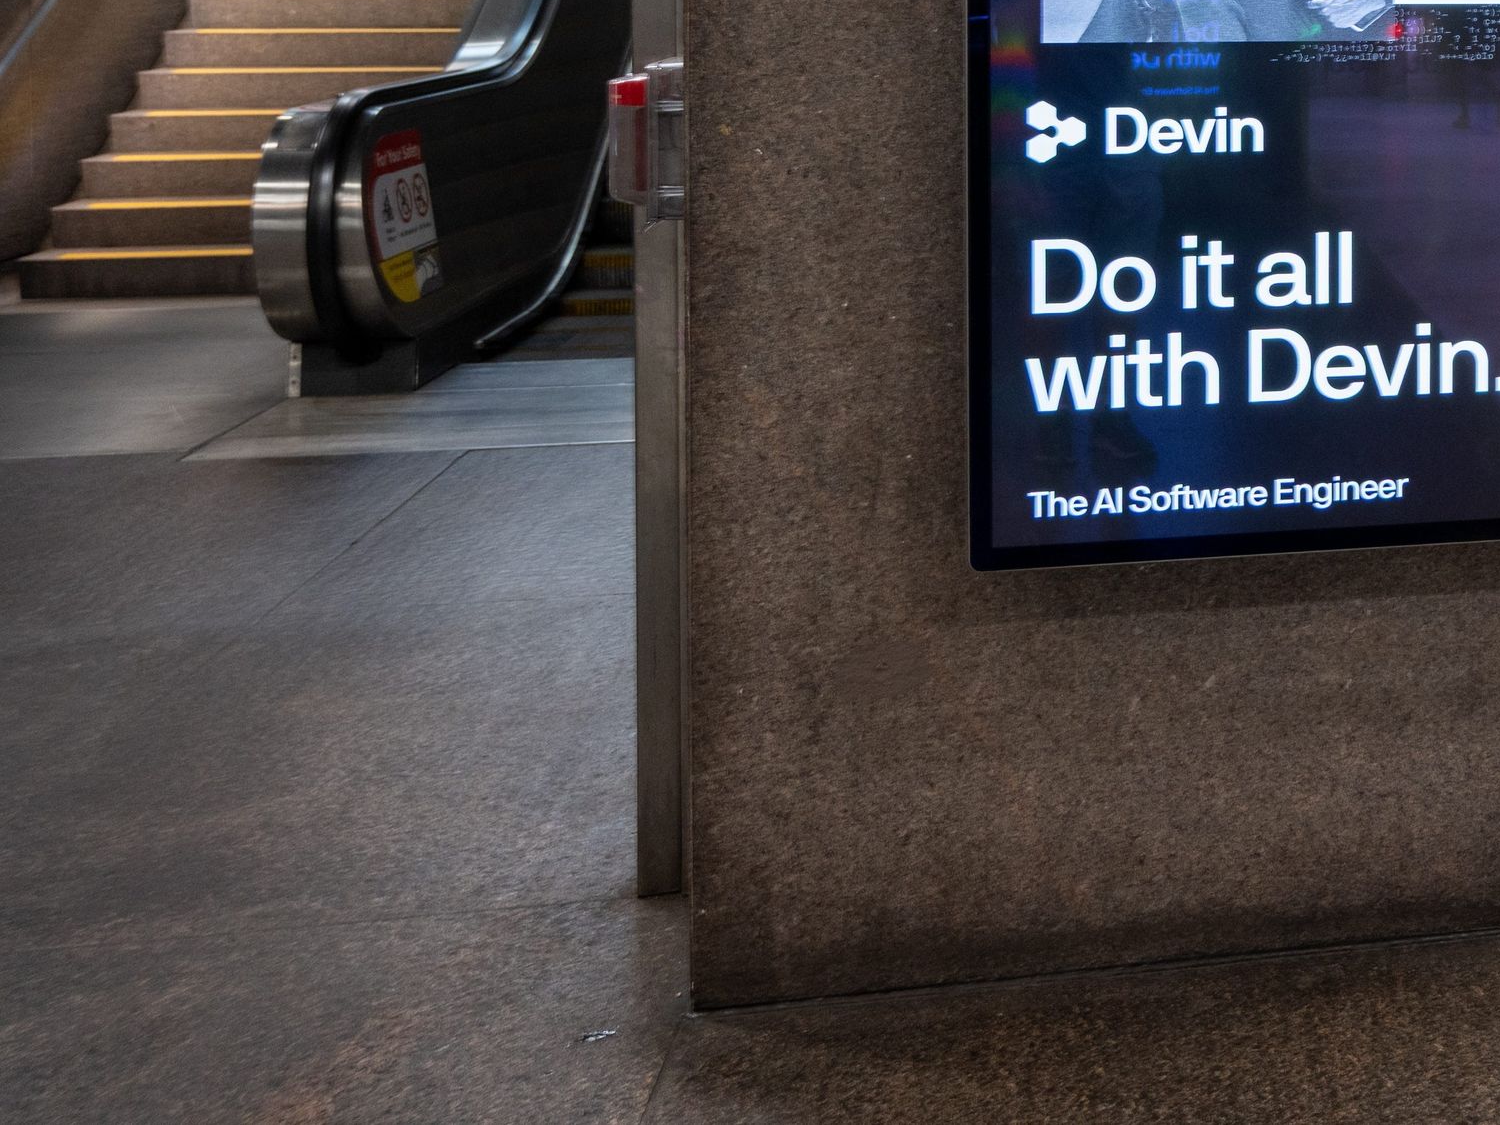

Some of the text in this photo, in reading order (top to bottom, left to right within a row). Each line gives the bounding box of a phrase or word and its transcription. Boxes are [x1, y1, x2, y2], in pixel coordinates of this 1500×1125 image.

[1105, 107, 1264, 155] Devin
[1031, 231, 1353, 314] Do it all
[1025, 332, 1220, 412] with
[1028, 475, 1409, 518] The AI Software Engineer
